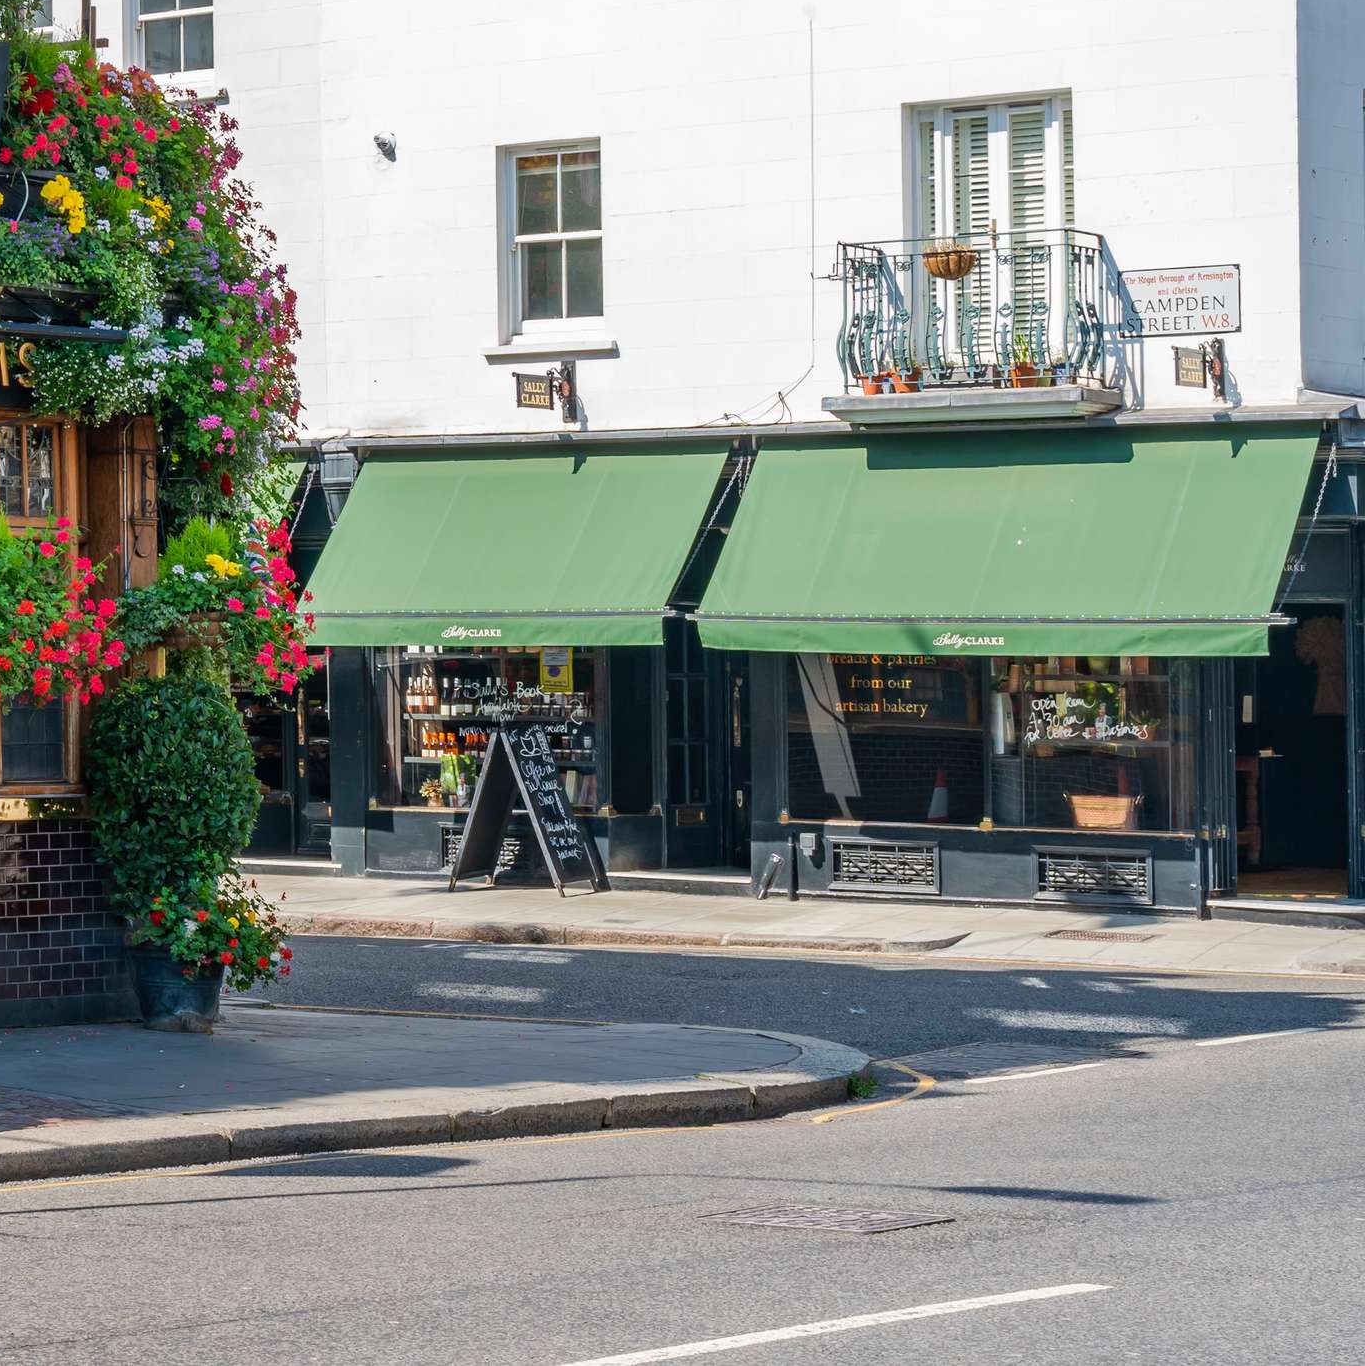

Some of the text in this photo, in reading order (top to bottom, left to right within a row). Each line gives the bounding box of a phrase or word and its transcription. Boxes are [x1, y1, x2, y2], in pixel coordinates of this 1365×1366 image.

[1130, 295, 1226, 314] CAMPDEN
[524, 381, 546, 393] SALLY
[521, 393, 550, 406] CLARKE
[850, 674, 913, 690] from our
[835, 698, 929, 718] artisan bakery
